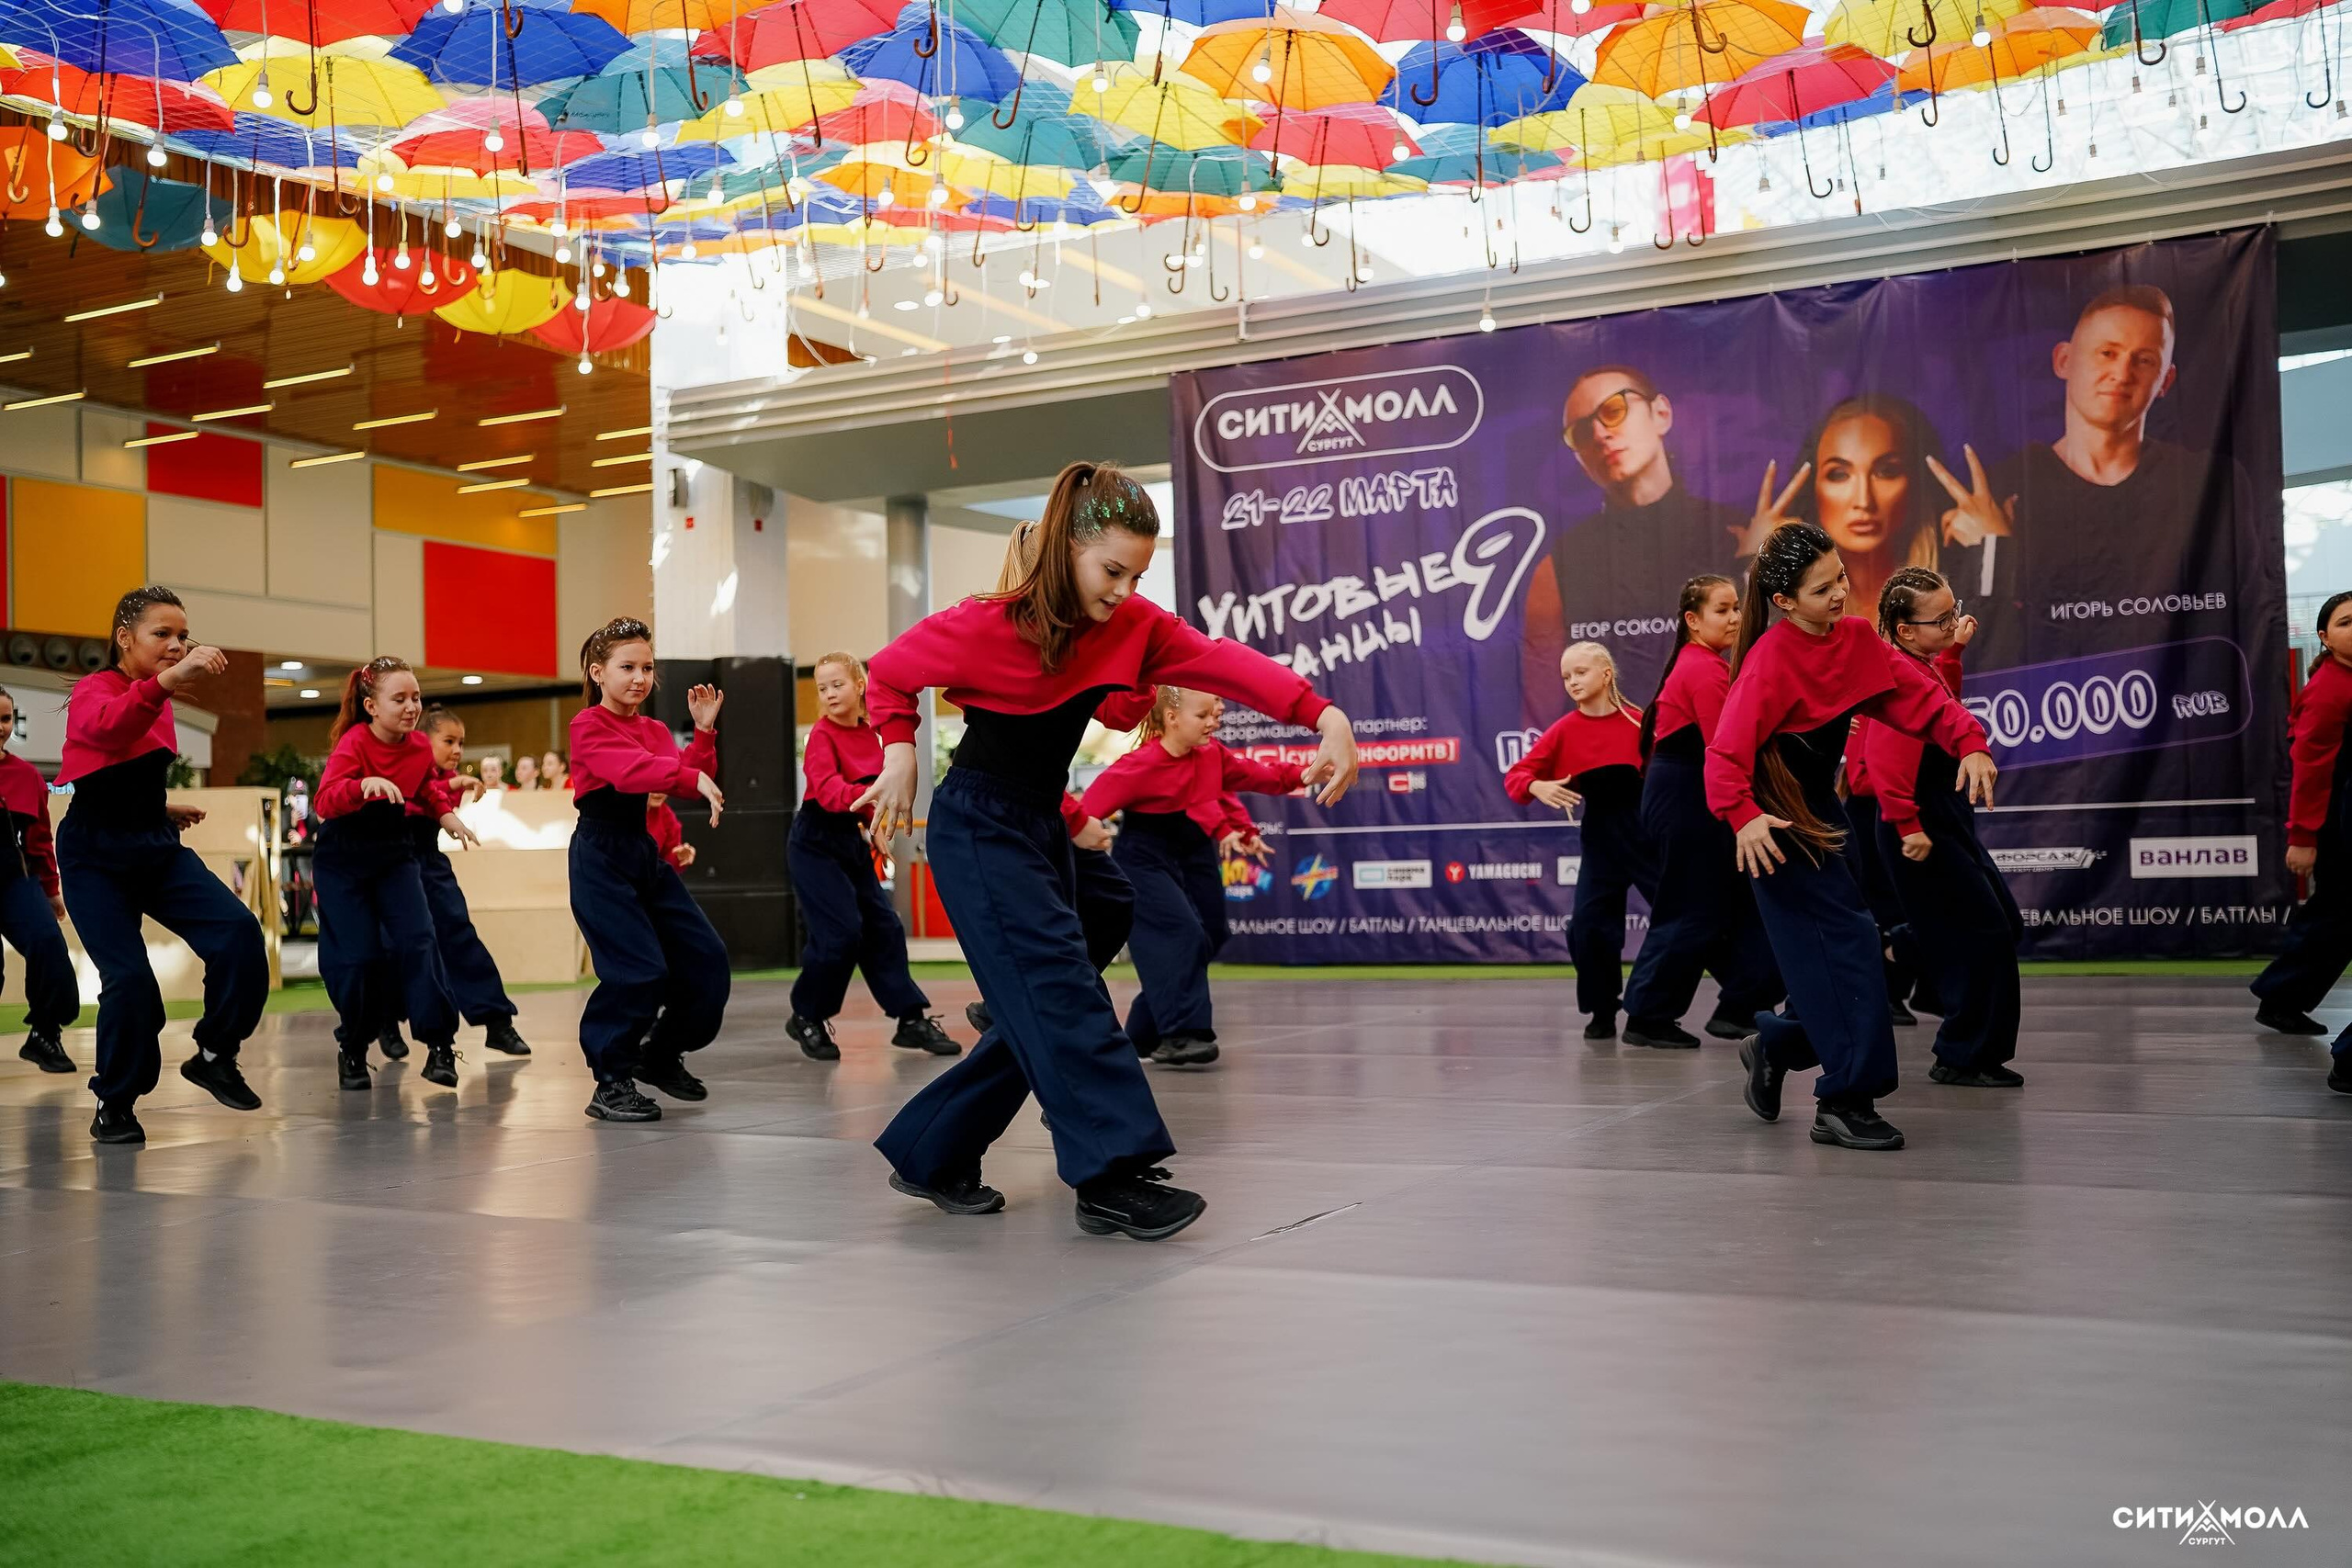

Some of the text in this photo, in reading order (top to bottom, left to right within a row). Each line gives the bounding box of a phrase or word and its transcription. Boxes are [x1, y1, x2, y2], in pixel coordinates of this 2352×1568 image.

[1306, 434, 1355, 453] СУРГУТ
[1221, 466, 1459, 530] 21-22 МАРТА
[2050, 592, 2228, 620] ИГОРЬ СОЛОВЬЕВ
[1570, 617, 1680, 639] ЕГОР СОКОЛ
[1270, 605, 1422, 677] АНЦЫ
[2172, 690, 2231, 719] RUB
[2139, 845, 2249, 867] ванлав
[1298, 917, 1337, 935] ШОУ
[1349, 916, 1406, 934] БАТТЛЫ
[1418, 915, 1541, 933] ТАНЦЕВАЛЬНОЕ
[1544, 915, 1573, 932] ШО
[2020, 907, 2124, 927] ЕВАЛЬНОЕ
[2128, 906, 2181, 926] ШОУ
[2200, 905, 2277, 925] БАТТЛЫ
